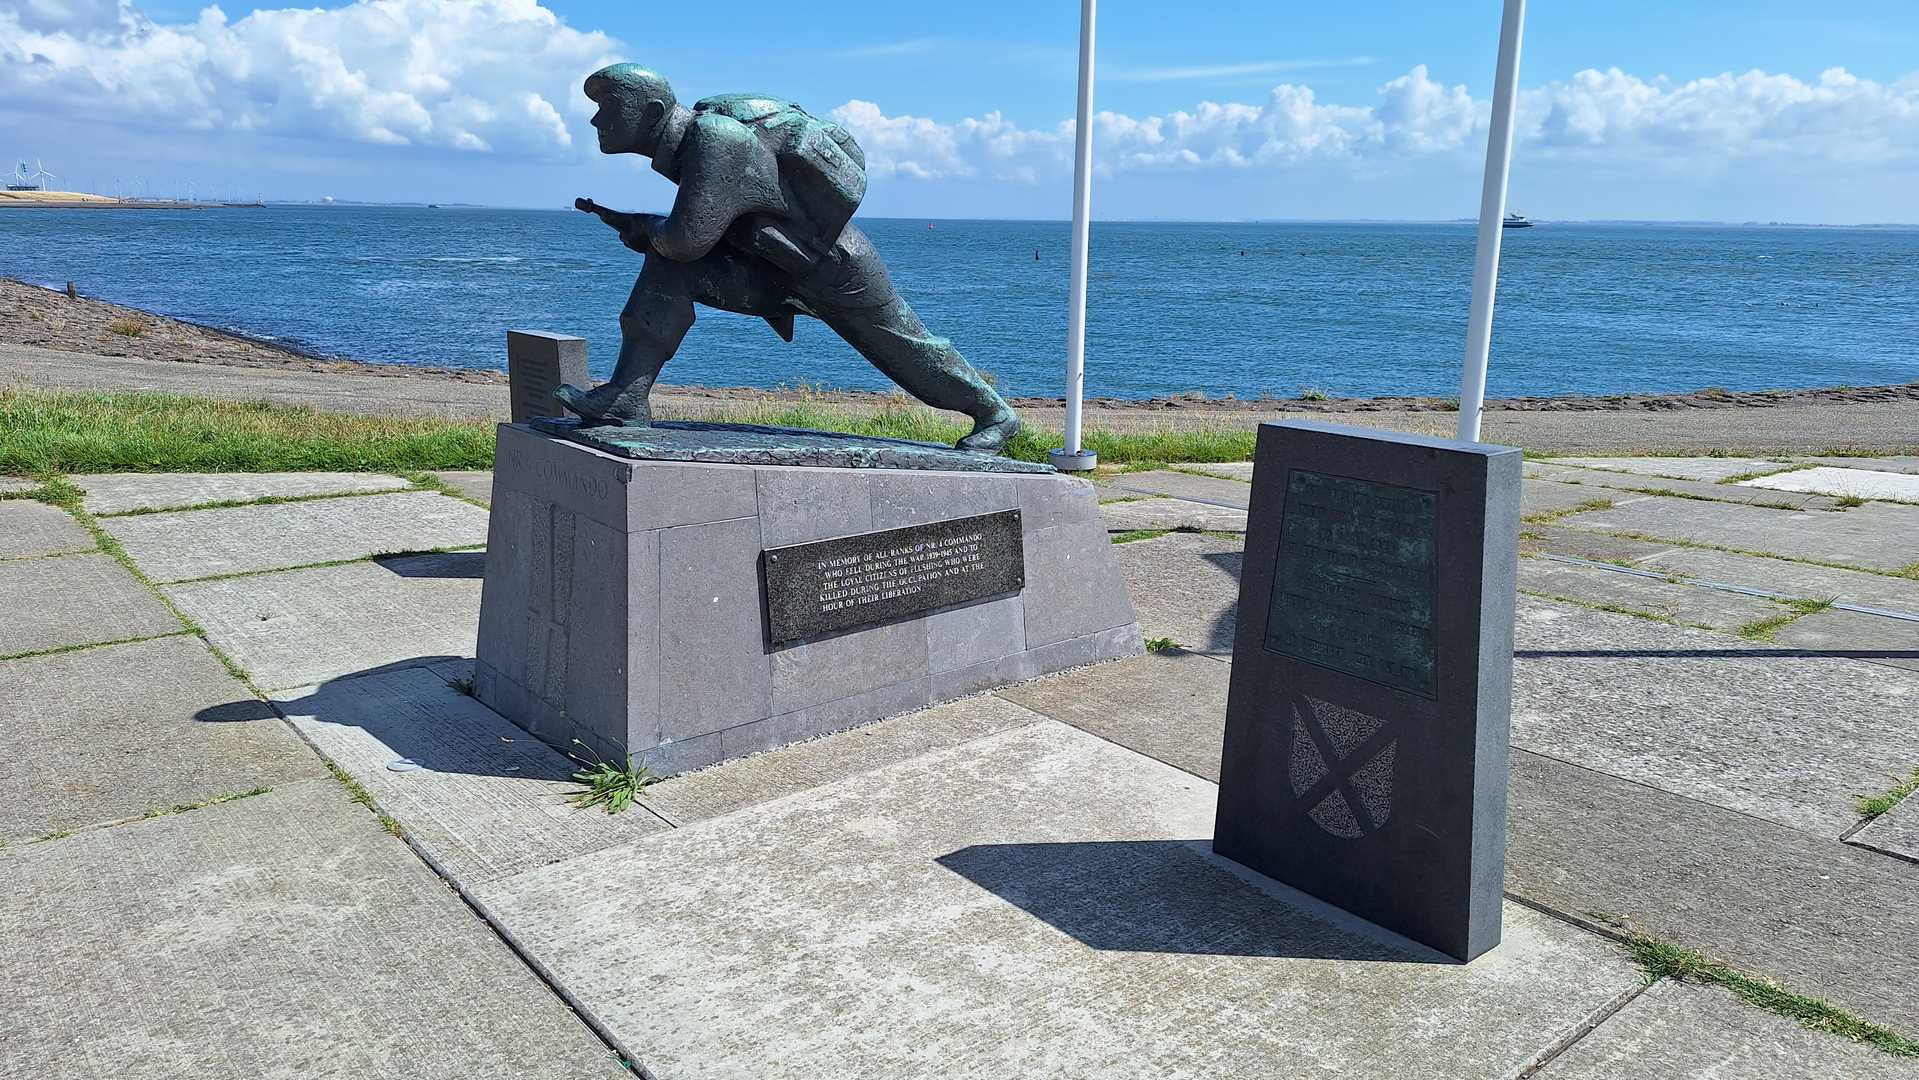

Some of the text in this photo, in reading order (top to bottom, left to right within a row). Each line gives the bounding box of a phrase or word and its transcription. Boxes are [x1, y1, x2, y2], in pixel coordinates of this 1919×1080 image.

[818, 560, 827, 570] IN
[829, 555, 860, 567] MEMORY
[863, 553, 873, 562] OF
[875, 551, 888, 559] ALL
[890, 546, 913, 557] RANKS
[915, 543, 924, 552] OF
[944, 533, 982, 546] COMMANDO
[824, 569, 843, 579] WHO
[845, 565, 861, 576] FELL
[865, 560, 892, 572] DURING
[894, 557, 908, 566] THE
[910, 553, 925, 562] WAR
[955, 546, 968, 554] AND
[970, 543, 978, 551] TO
[820, 562, 985, 602] KILLED DURING THE OCCUPATION AND AT THE
[823, 553, 982, 591] THE LOYAL CITIZENS OF FLUSHING WHO WERE
[822, 585, 921, 612] HOUR OF THEIR LIBERATION
